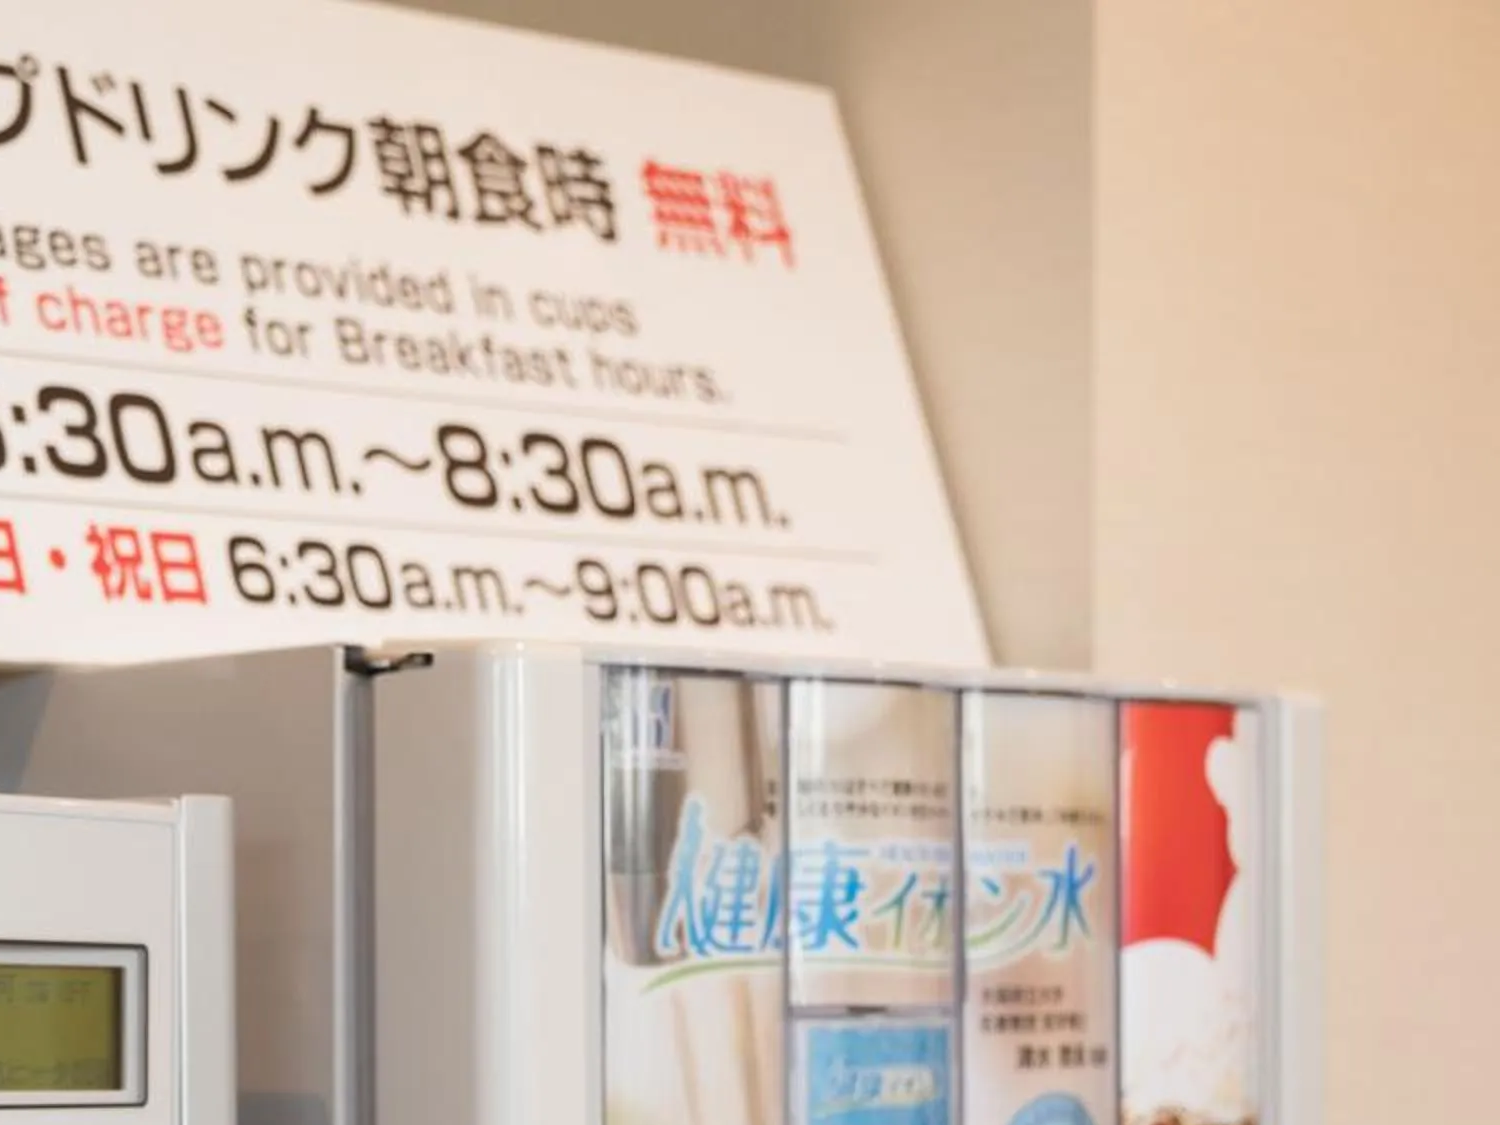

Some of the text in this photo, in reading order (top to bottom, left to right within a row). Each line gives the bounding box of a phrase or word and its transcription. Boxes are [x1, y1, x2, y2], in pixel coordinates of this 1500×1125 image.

[641, 157, 797, 268] 無料
[36, 285, 226, 353] charge
[242, 307, 313, 356] for
[334, 315, 578, 392] Breakfast
[589, 349, 731, 403] hours.
[134, 239, 219, 286] are
[240, 252, 454, 315] provided
[468, 271, 516, 322] in
[530, 293, 641, 338] cups
